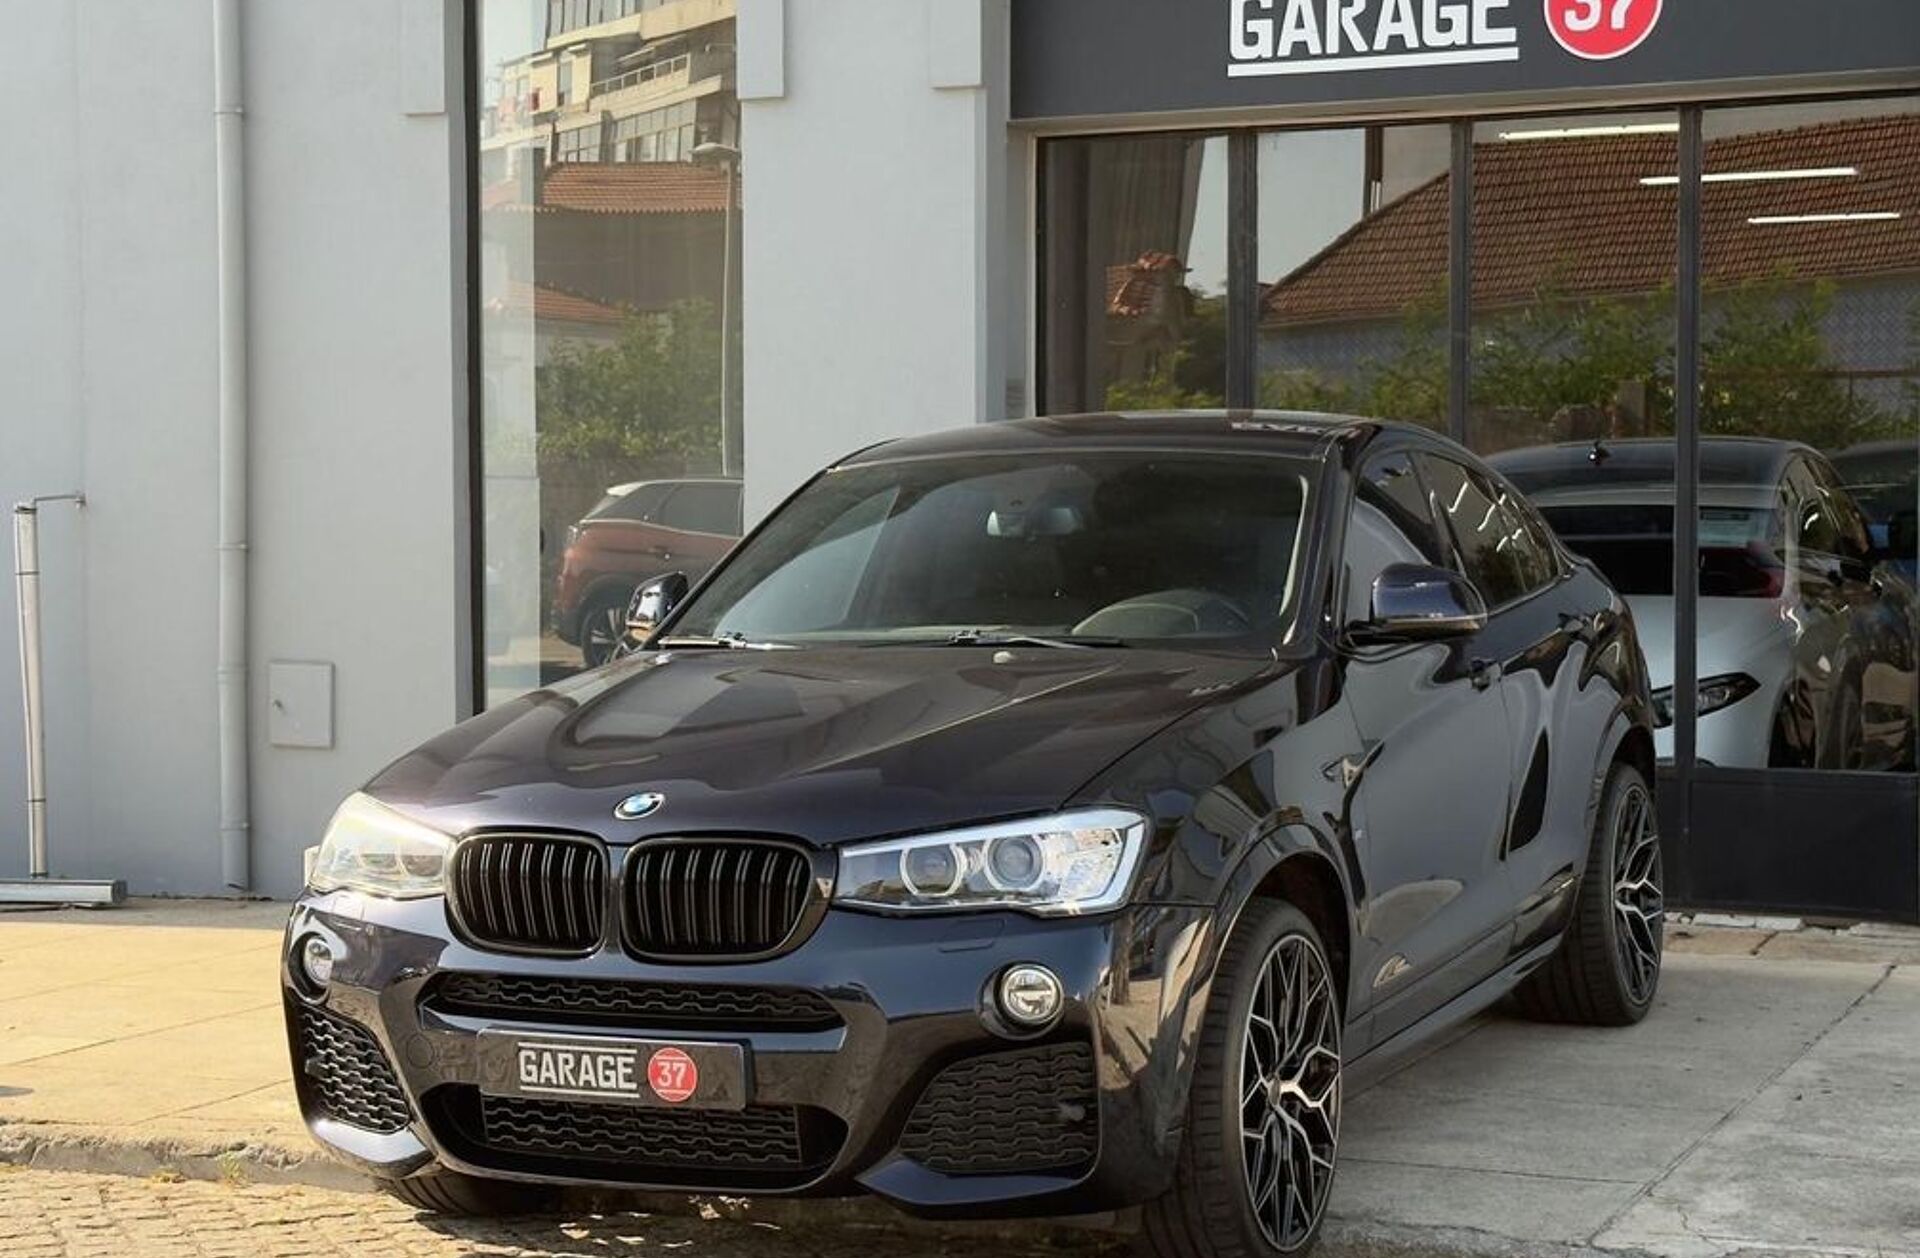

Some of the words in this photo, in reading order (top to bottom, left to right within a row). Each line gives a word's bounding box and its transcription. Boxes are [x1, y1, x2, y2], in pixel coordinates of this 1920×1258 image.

[1230, 0, 1517, 60] GARAGE
[519, 1049, 638, 1090] GARAGE
[657, 1060, 688, 1088] 37
